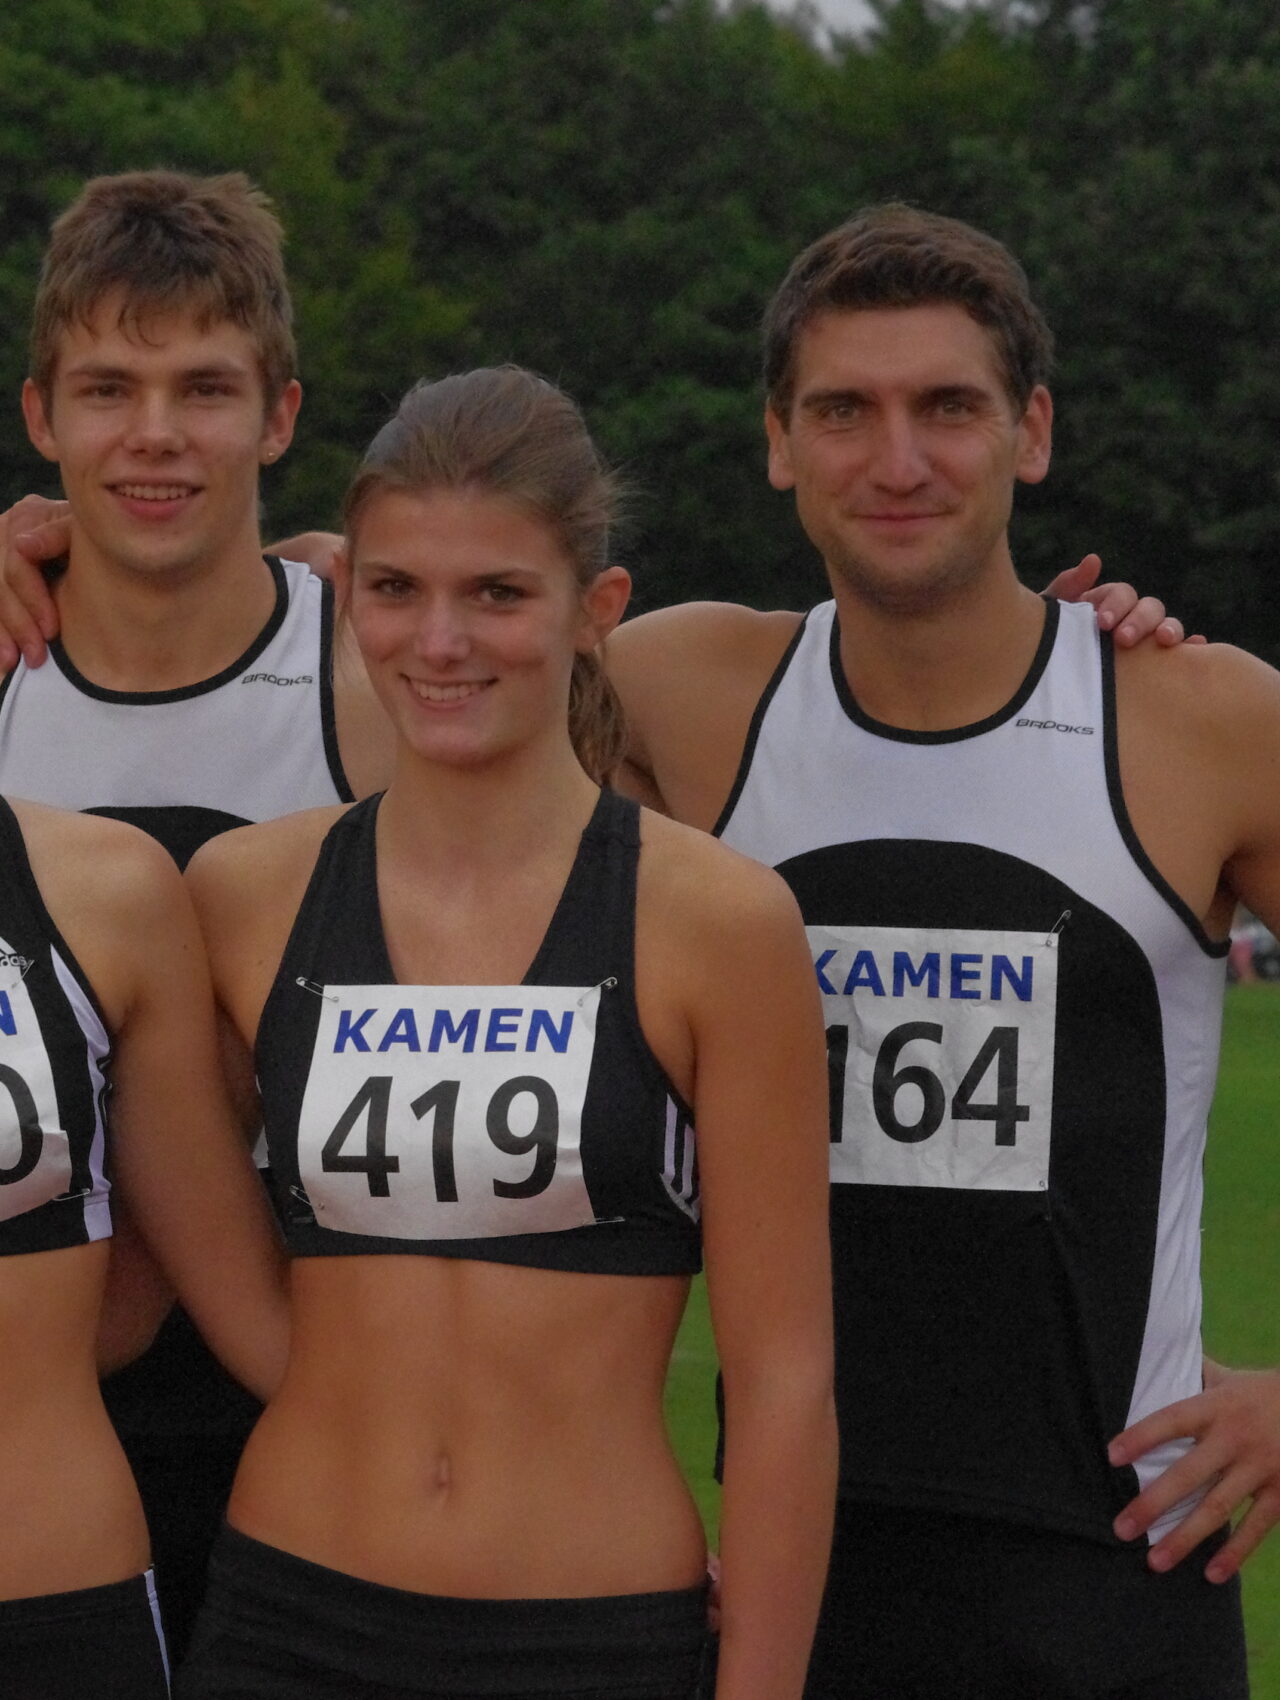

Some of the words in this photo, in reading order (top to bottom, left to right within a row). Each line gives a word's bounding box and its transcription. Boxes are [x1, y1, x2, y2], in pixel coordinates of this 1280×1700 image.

[241, 673, 313, 686] BROOKS
[1016, 718, 1095, 735] BROOKS
[815, 949, 1034, 1002] KAMEN
[333, 1008, 575, 1054] KAMEN
[826, 1021, 1030, 1147] 164
[321, 1075, 559, 1203] 419
